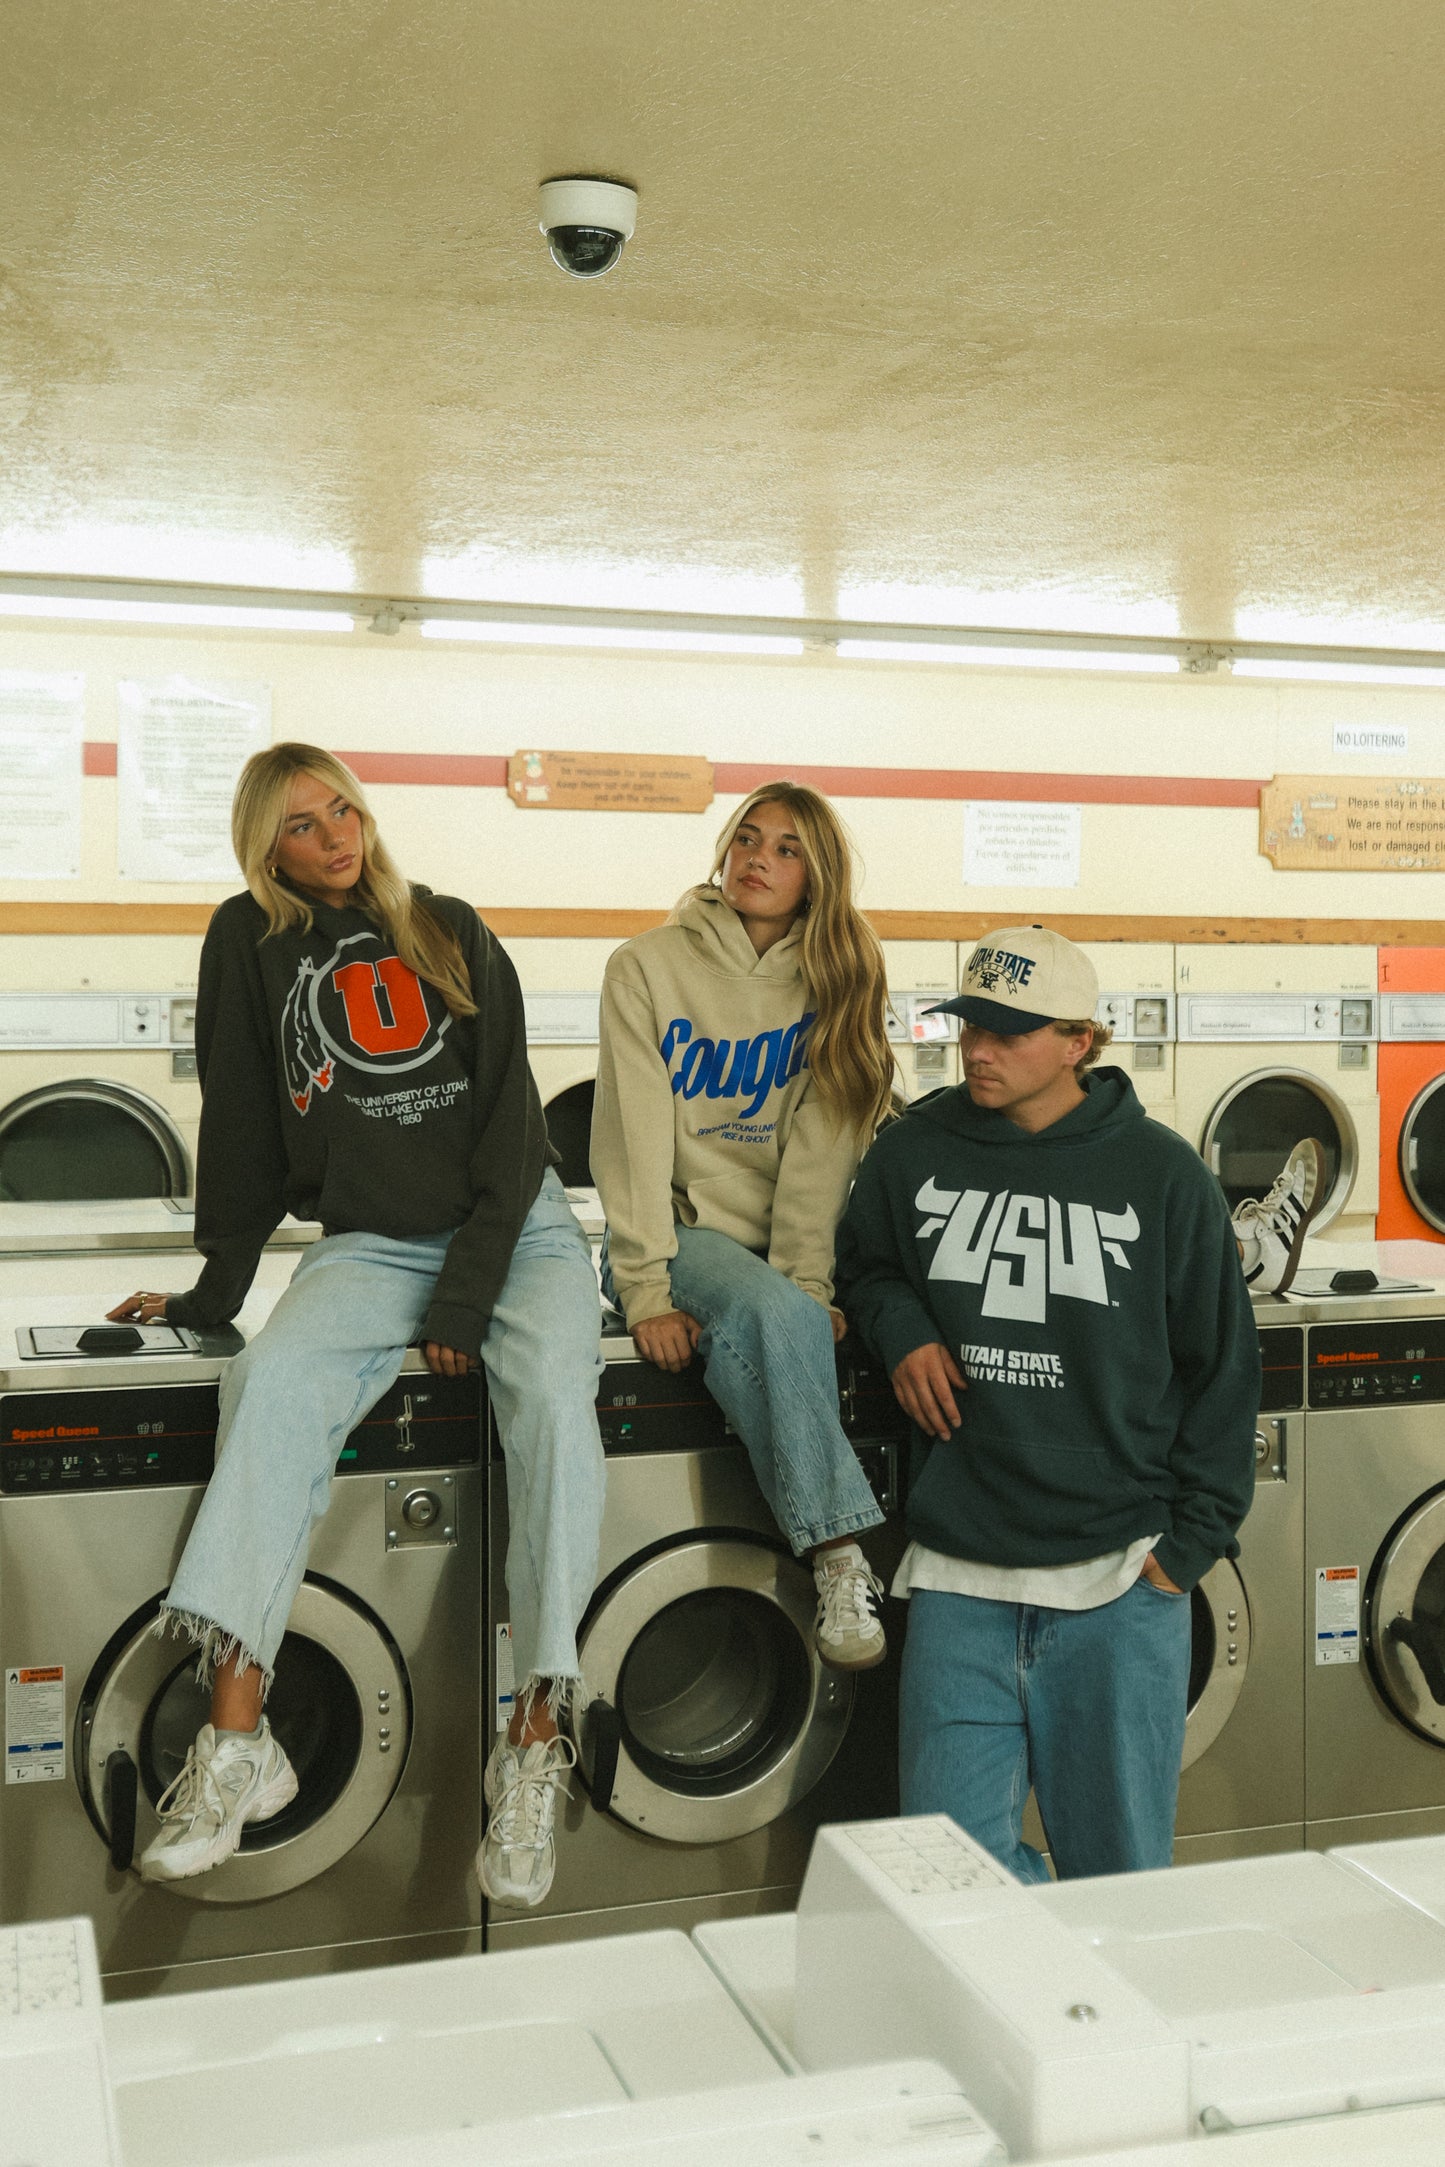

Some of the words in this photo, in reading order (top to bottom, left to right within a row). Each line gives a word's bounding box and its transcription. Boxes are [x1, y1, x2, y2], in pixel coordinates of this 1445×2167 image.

[1336, 732, 1350, 746] NO
[1353, 733, 1406, 748] LOITERING
[1348, 796, 1380, 810] Please
[1384, 798, 1406, 812] stay
[1409, 798, 1418, 810] in
[1422, 798, 1438, 811] the
[1347, 818, 1362, 831] We
[1366, 821, 1382, 831] are
[1386, 820, 1402, 832] not
[1406, 821, 1445, 834] respons
[1349, 840, 1368, 851] lost
[1372, 842, 1382, 851] or
[1386, 840, 1430, 855] damaged
[968, 948, 994, 972] UTAH
[994, 950, 1036, 986] STATE
[1180, 966, 1190, 984] H
[332, 955, 432, 1056] U
[344, 1094, 362, 1107] THE
[362, 1089, 422, 1107] UNIVERSITY
[424, 1085, 440, 1098] OF
[441, 1080, 468, 1094] UTAH
[361, 1107, 384, 1118] SALT
[384, 1103, 414, 1117] LAKE
[414, 1098, 440, 1112] CITY,
[440, 1095, 456, 1108] UT
[397, 1112, 422, 1126] 1850
[697, 1122, 731, 1136] BRIGHAM
[732, 1122, 758, 1134] YOUNG
[720, 1131, 738, 1141] RISE
[738, 1134, 744, 1142] &
[744, 1135, 772, 1144] SHOUT
[928, 1189, 1109, 1324] USU
[960, 1343, 1004, 1367] UTAH
[1008, 1350, 1064, 1374] STATE
[1316, 1352, 1348, 1364] Speed
[1348, 1352, 1380, 1361] Queen
[964, 1364, 1057, 1388] UNIVERSITY
[12, 1426, 54, 1442] Speed
[56, 1426, 100, 1438] Queen
